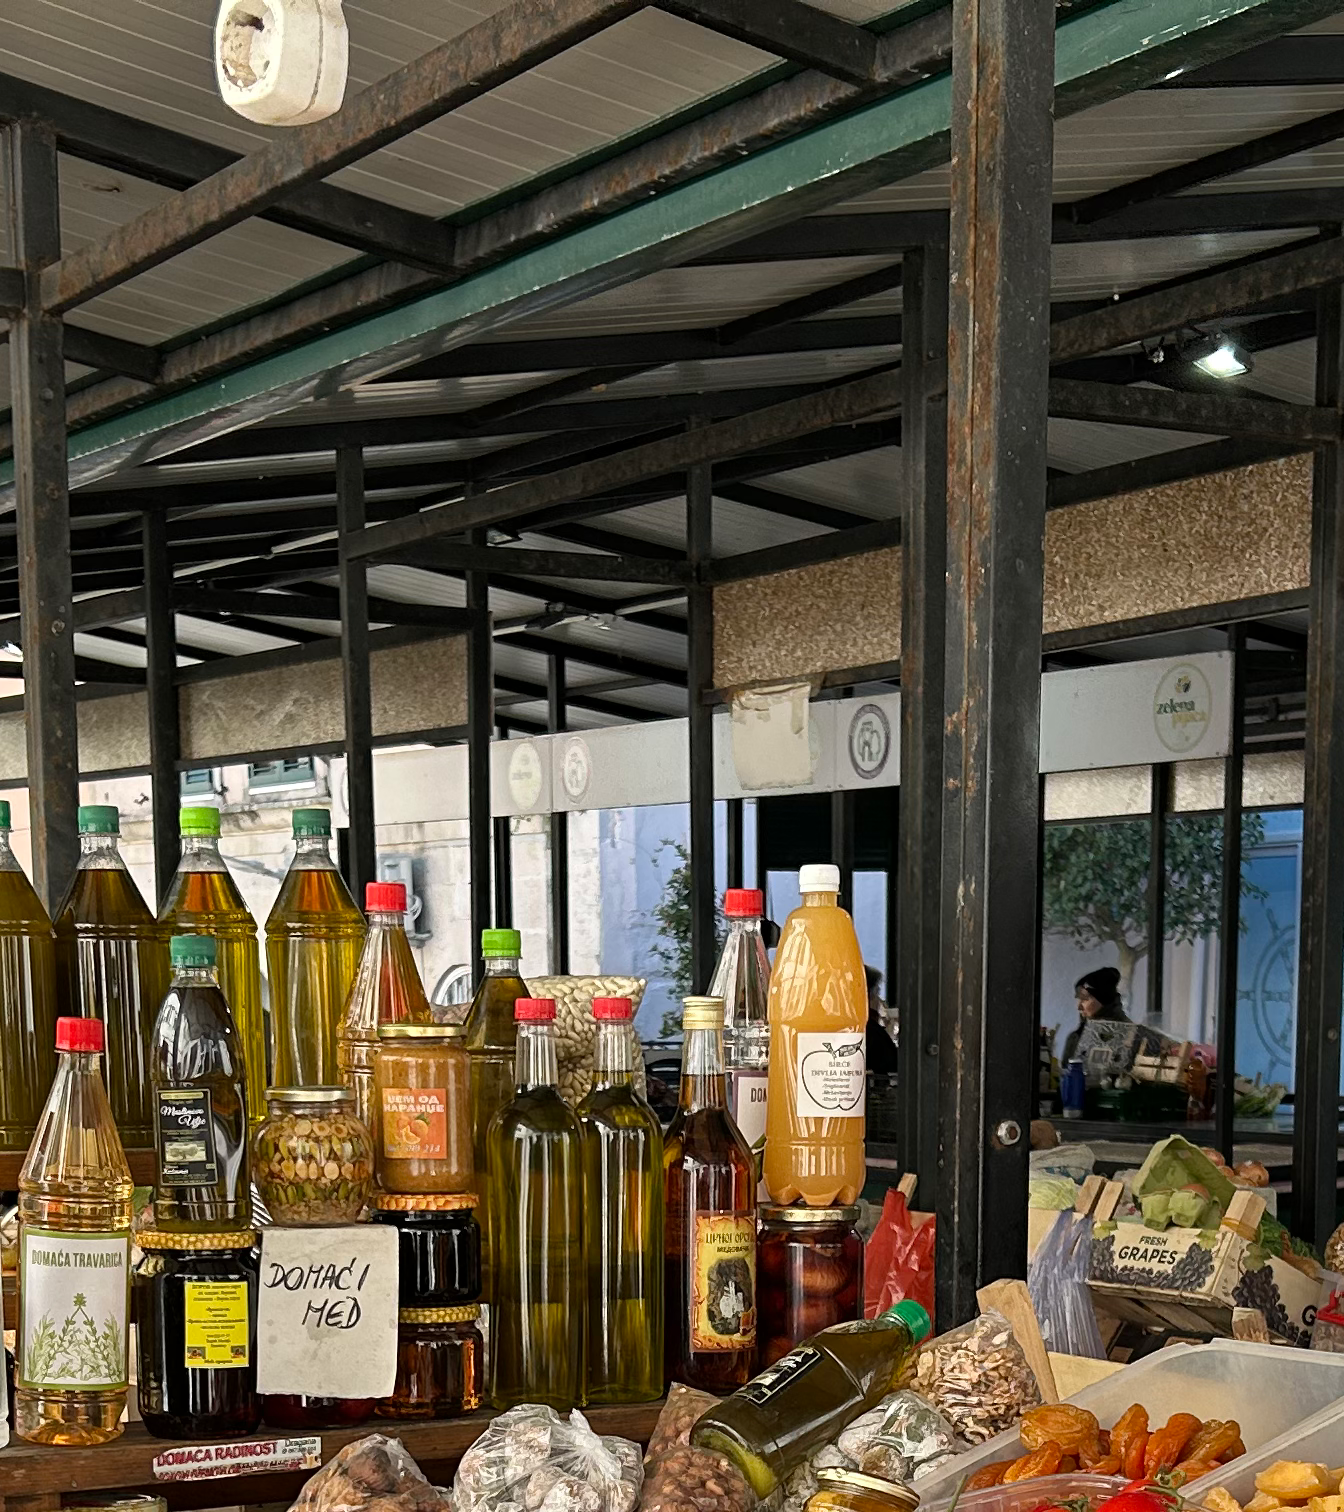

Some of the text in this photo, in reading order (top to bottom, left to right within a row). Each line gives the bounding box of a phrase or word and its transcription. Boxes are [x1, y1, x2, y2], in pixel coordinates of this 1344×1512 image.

[1138, 1235, 1169, 1247] FRESH
[31, 1248, 123, 1268] DOMAĆA TRAVARICA
[1118, 1245, 1179, 1265] GRAPES
[263, 1256, 371, 1292] DOMAĆI
[301, 1296, 362, 1330] MED
[215, 1441, 278, 1461] RADINOST
